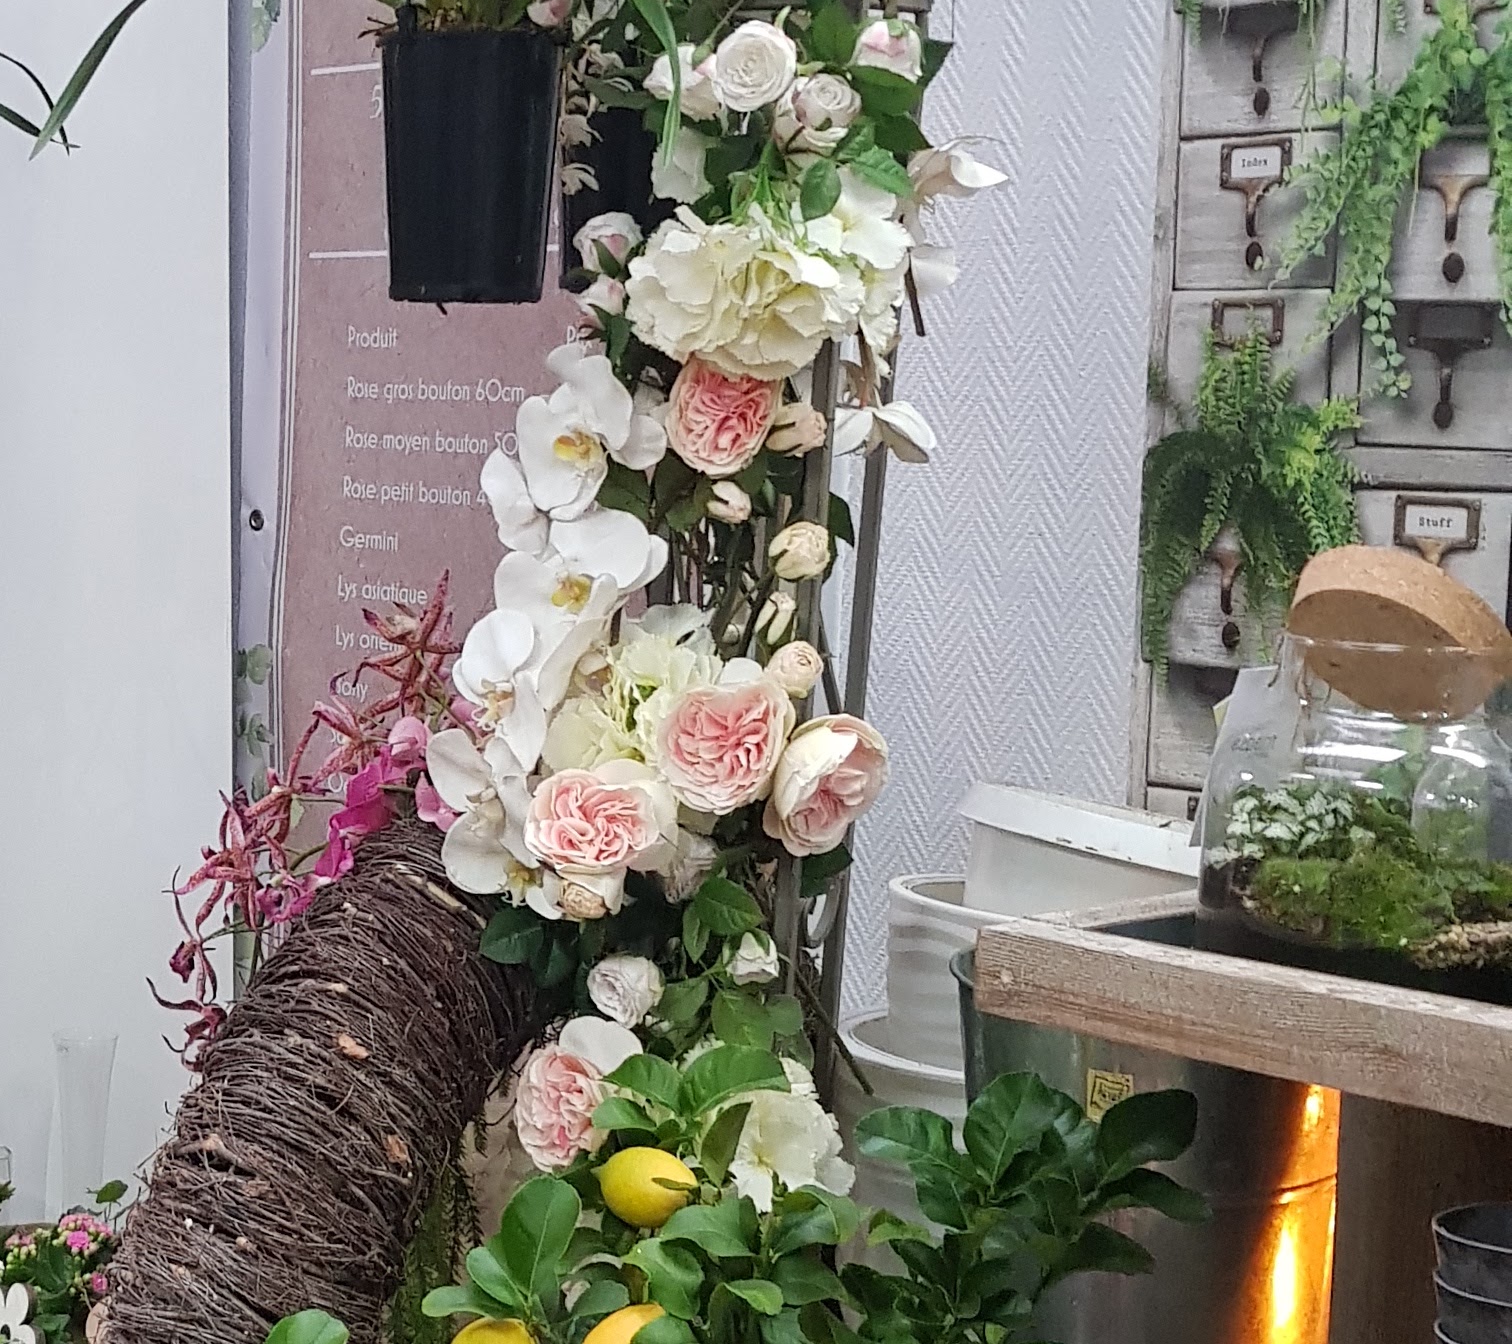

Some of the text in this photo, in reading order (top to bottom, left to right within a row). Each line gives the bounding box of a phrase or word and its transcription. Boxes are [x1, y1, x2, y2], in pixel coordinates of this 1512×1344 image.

[1241, 157, 1268, 168] Index
[348, 325, 397, 348] Produit
[347, 375, 525, 404] Rose gros bouton 60cm
[345, 425, 377, 449] Rose
[382, 433, 430, 455] moyen
[435, 429, 488, 455] bouton
[343, 475, 377, 499] Rose
[381, 482, 414, 504] petit
[418, 480, 471, 506] bouton
[1419, 516, 1453, 528] Stuff
[339, 525, 399, 553] Germini
[337, 574, 428, 605] Lys asiatique
[335, 625, 354, 651] Lys
